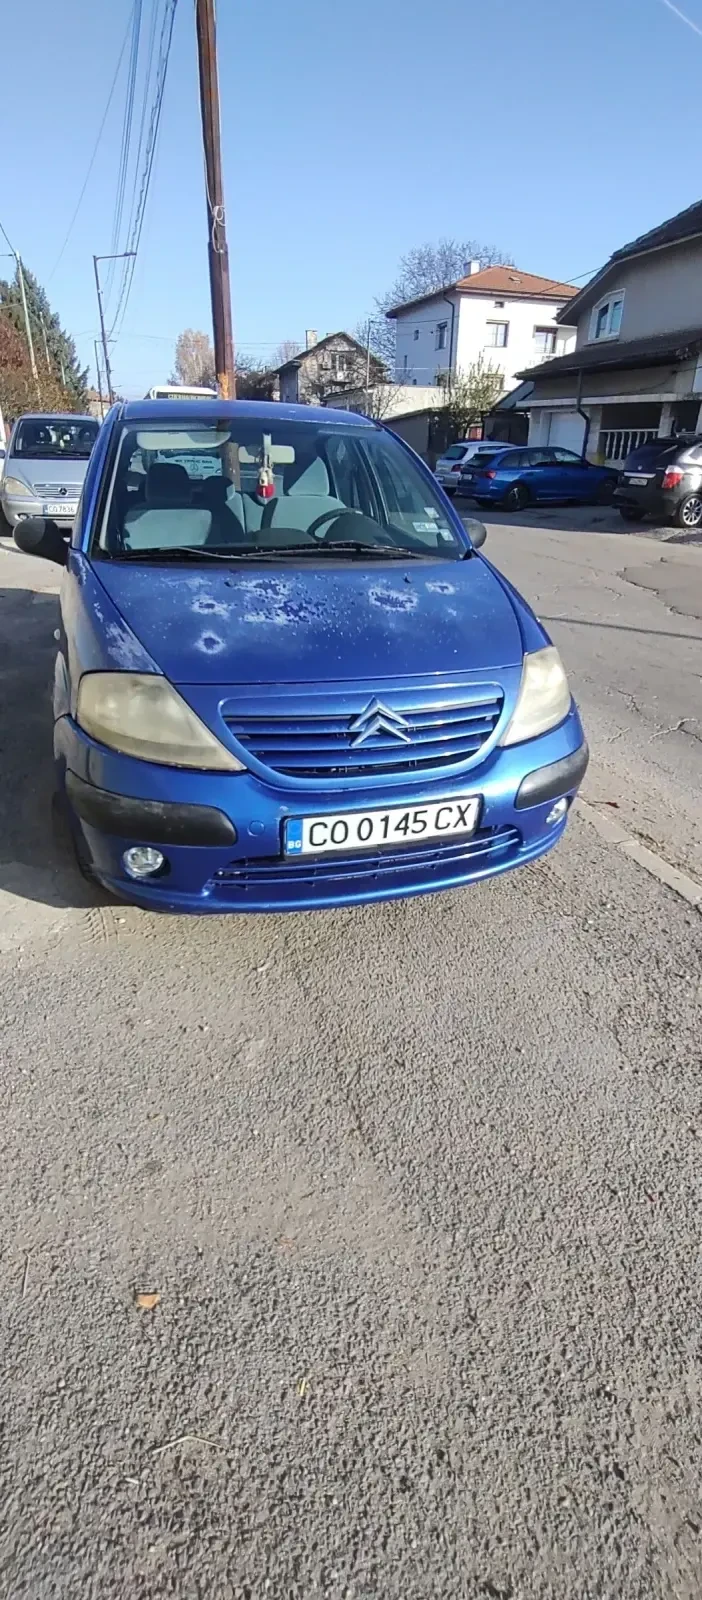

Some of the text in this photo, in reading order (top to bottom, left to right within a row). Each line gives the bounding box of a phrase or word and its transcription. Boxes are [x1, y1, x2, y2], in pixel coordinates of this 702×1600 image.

[309, 803, 472, 847] CO 0145 CX
[287, 840, 302, 849] BG
